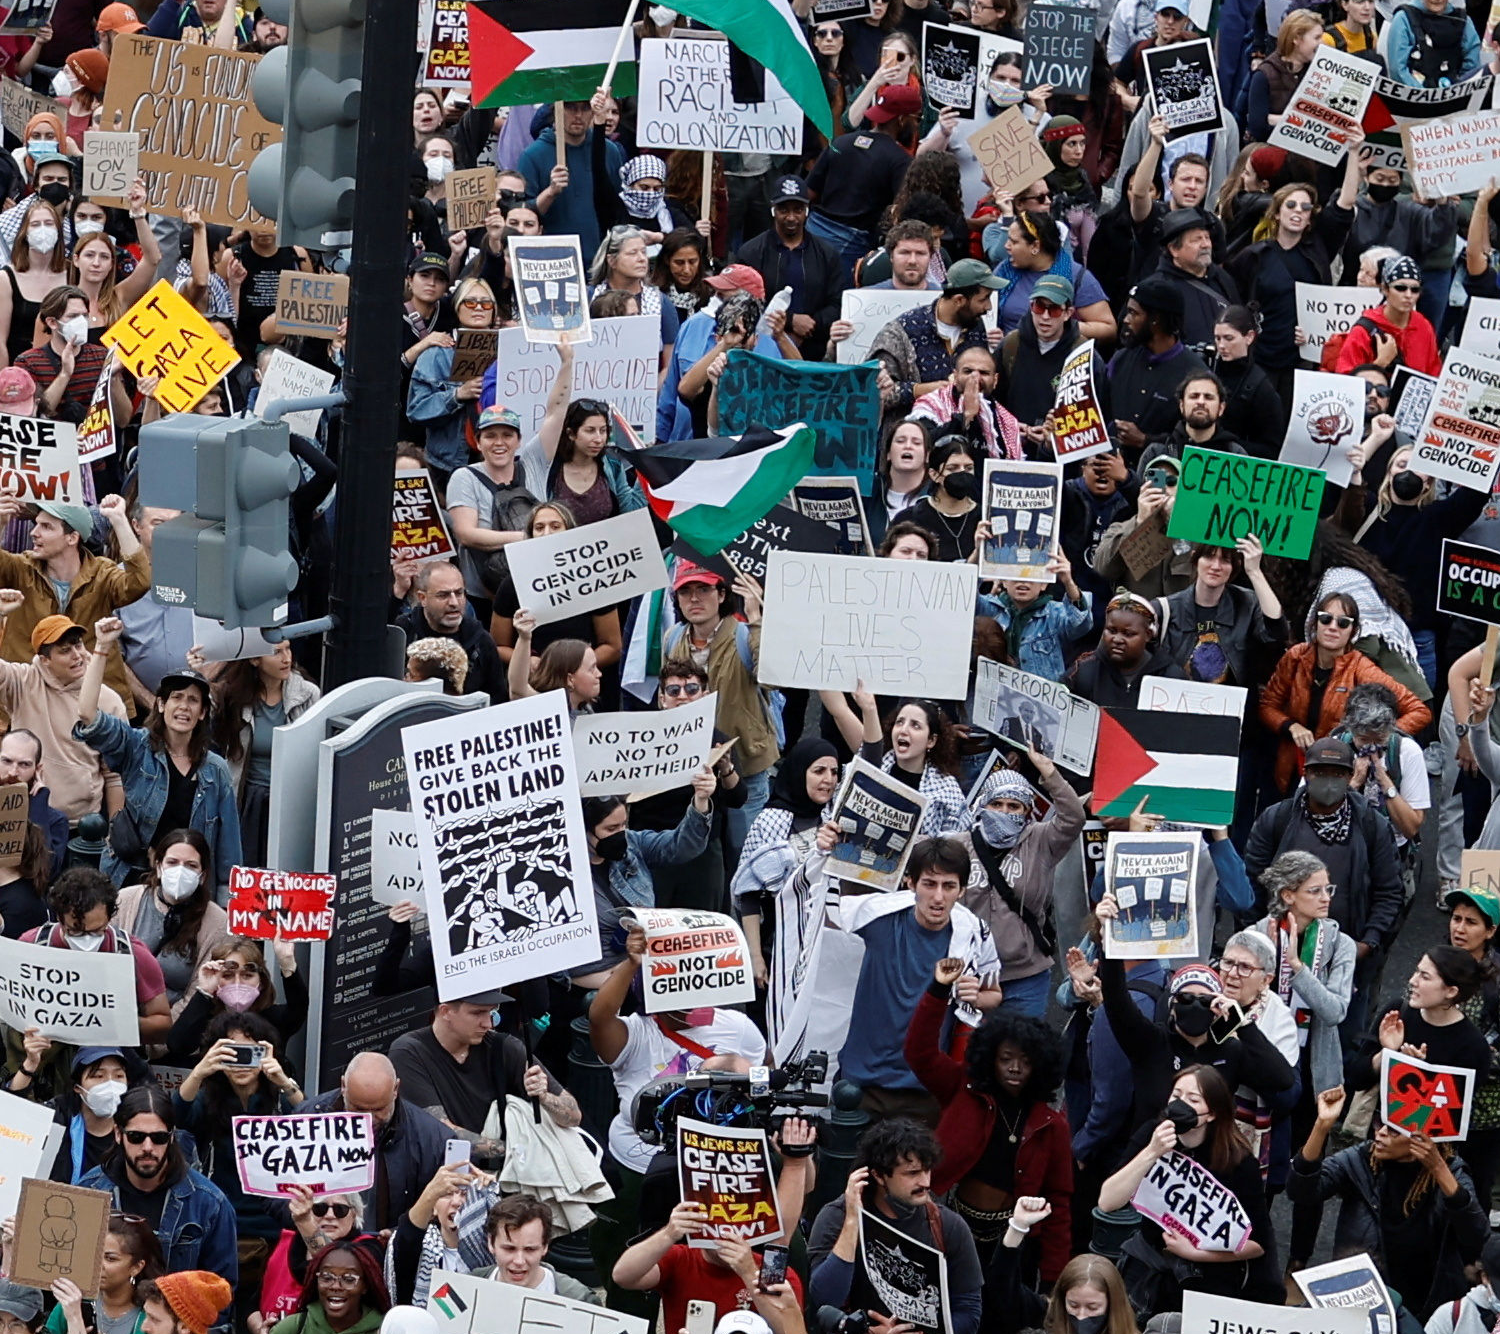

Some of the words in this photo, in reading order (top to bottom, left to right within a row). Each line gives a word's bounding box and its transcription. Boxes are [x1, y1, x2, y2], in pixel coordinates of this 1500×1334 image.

[1029, 10, 1066, 29] STOP
[1070, 13, 1094, 33] THE
[1028, 36, 1084, 59] SIEGE
[1026, 59, 1088, 89] NOW
[111, 296, 169, 357] LET
[136, 328, 204, 380] GAZA
[160, 348, 230, 412] LIVE
[781, 564, 975, 612] PALESTINIAN
[1446, 580, 1464, 599] IS
[1470, 586, 1484, 605] A
[821, 612, 922, 652] LIVES
[792, 647, 927, 688] MATTER
[414, 747, 456, 772] FREE
[461, 716, 562, 761] PALESTINE!
[418, 767, 465, 792] GIVE
[471, 752, 522, 780] BACK
[528, 743, 562, 764] THE
[423, 781, 502, 818] STOLEN
[509, 763, 566, 798] LAND
[236, 874, 255, 888] NO
[259, 874, 336, 891] GENOCIDE
[267, 895, 282, 909] IN
[232, 911, 261, 930] MY
[276, 911, 333, 931] NAME
[236, 1117, 366, 1142] CEASEFIRE
[237, 1142, 263, 1158] IN
[261, 1144, 334, 1176] GAZA
[337, 1147, 375, 1163] NOW
